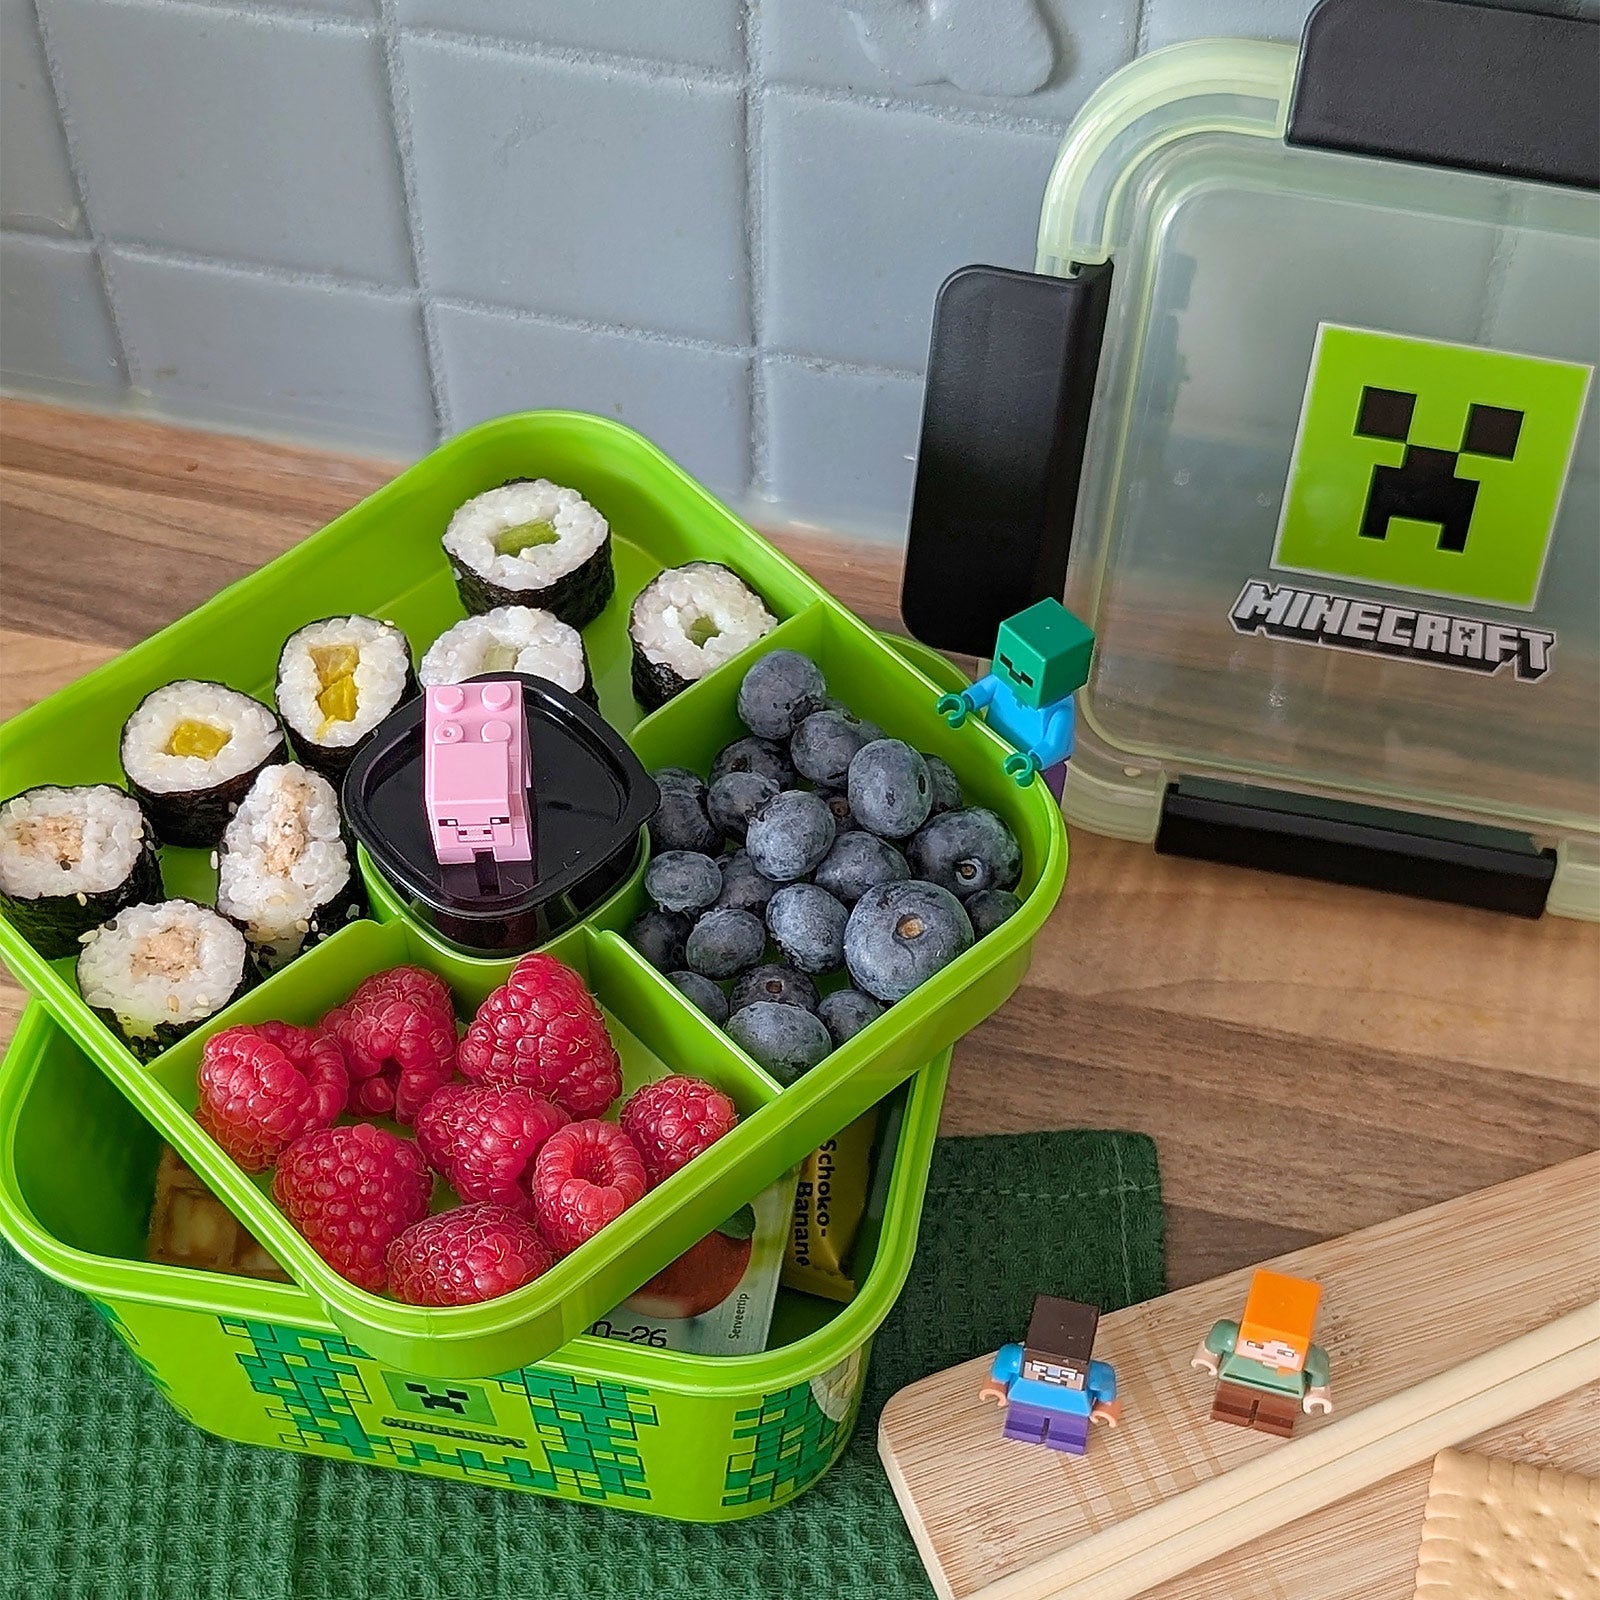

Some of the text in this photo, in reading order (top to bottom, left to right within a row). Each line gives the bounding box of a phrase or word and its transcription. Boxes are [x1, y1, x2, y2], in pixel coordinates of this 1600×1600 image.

[1231, 583, 1555, 680] MINECRAFT
[816, 1138, 837, 1237] Schoko-
[728, 1293, 750, 1340] Serveertip
